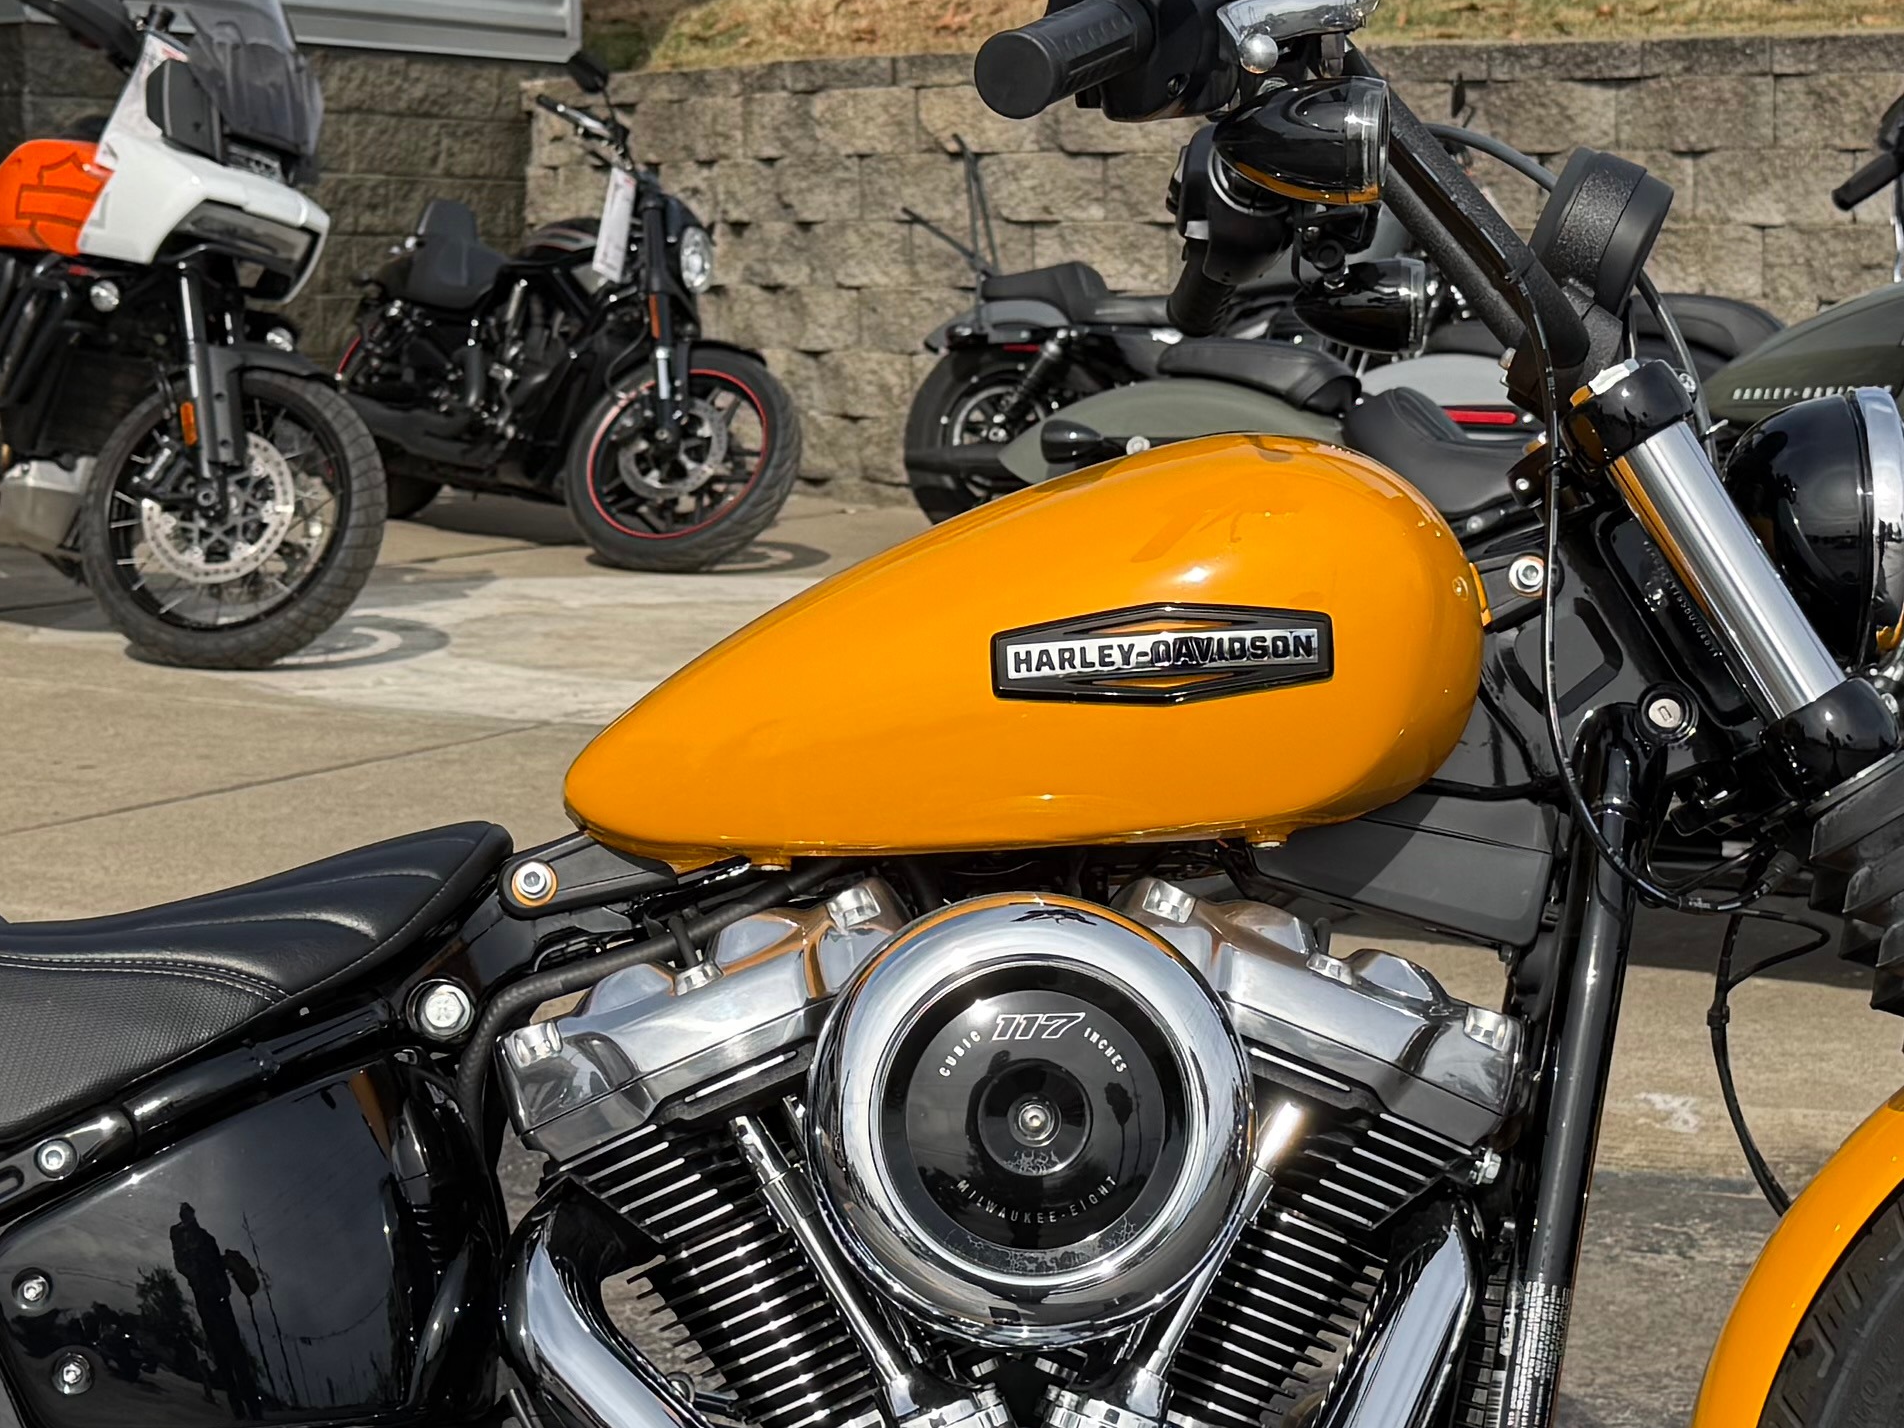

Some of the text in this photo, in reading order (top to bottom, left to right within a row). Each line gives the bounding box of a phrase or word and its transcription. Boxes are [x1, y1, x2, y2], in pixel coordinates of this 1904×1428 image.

[1013, 633, 1315, 675] HARLEY-DAVIDSON
[938, 1011, 1128, 1078] CUBIC 117 INCHES
